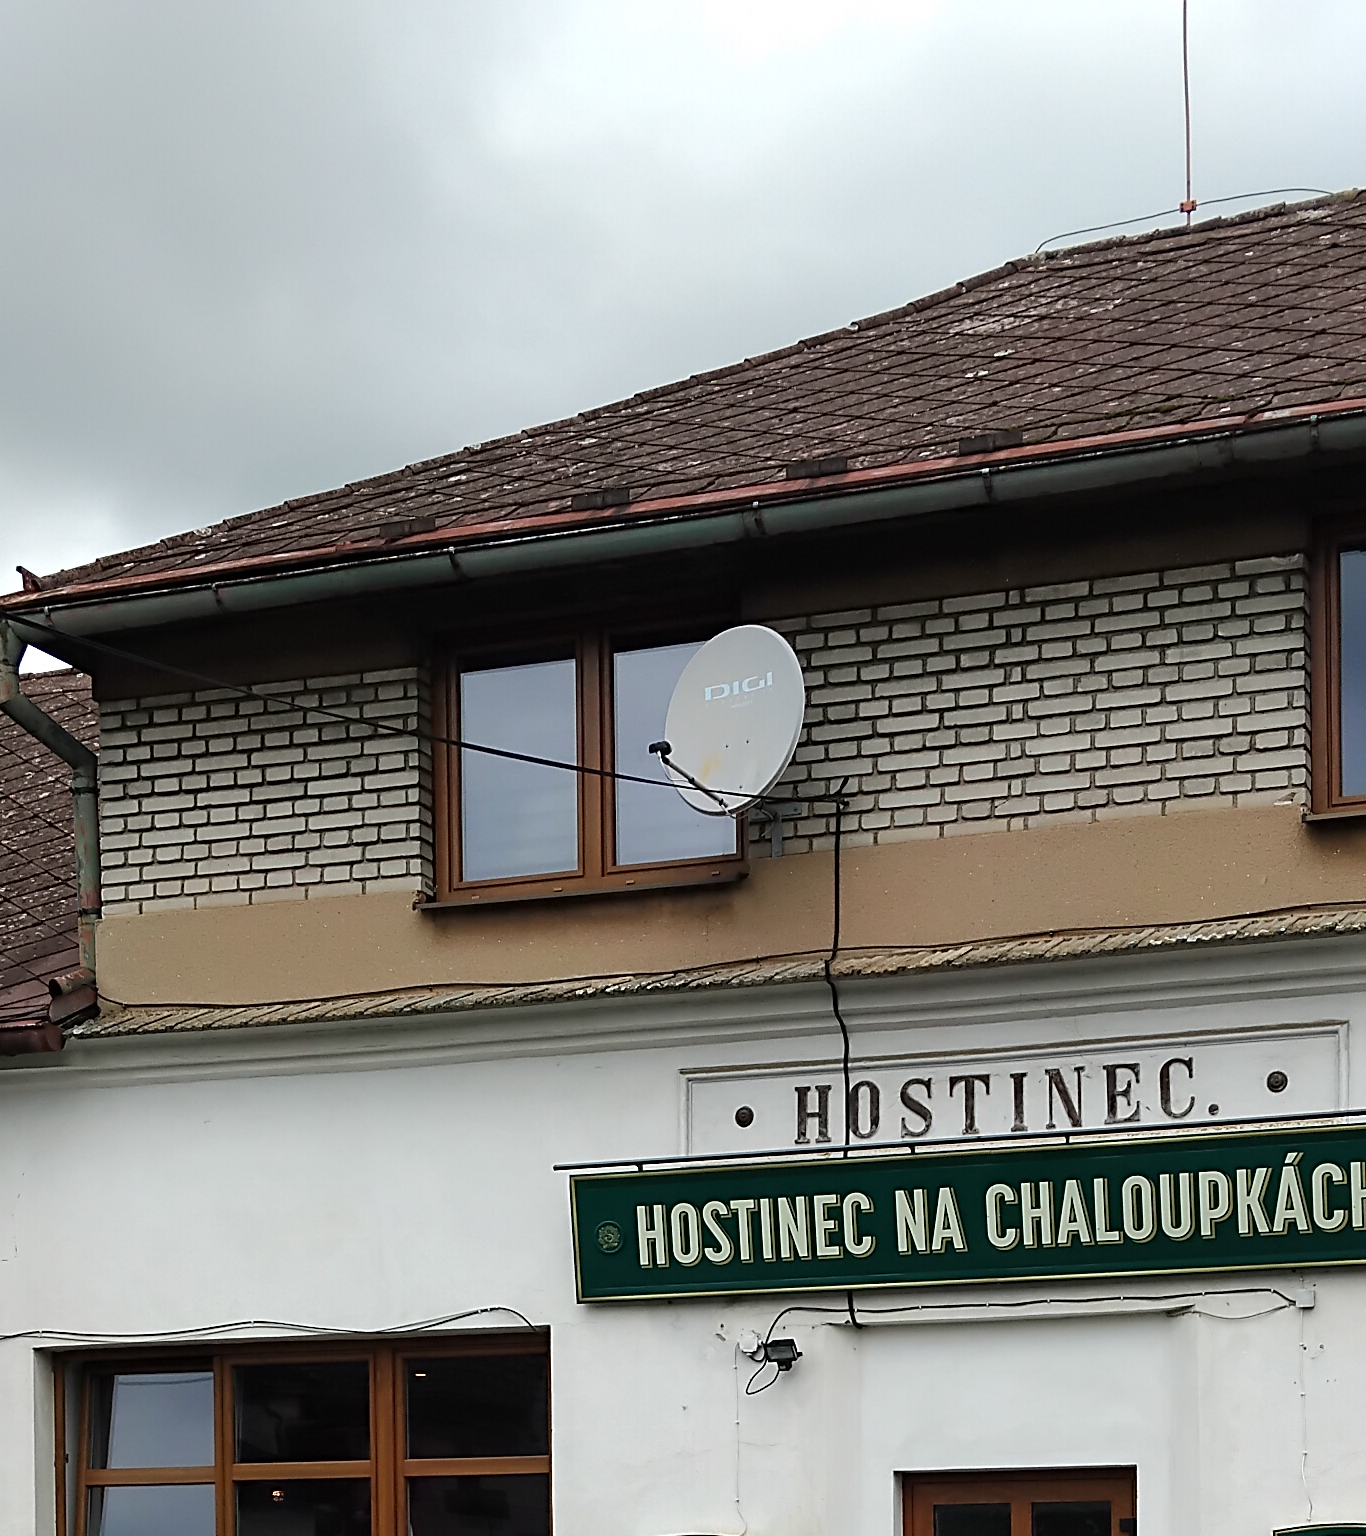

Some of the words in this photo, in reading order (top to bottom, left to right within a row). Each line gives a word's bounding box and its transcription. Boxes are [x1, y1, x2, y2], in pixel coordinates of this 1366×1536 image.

[704, 671, 773, 701] DIGI
[794, 1056, 1220, 1144] HOSTINEC.
[636, 1192, 875, 1269] HOSTINEC
[894, 1187, 968, 1255] NA
